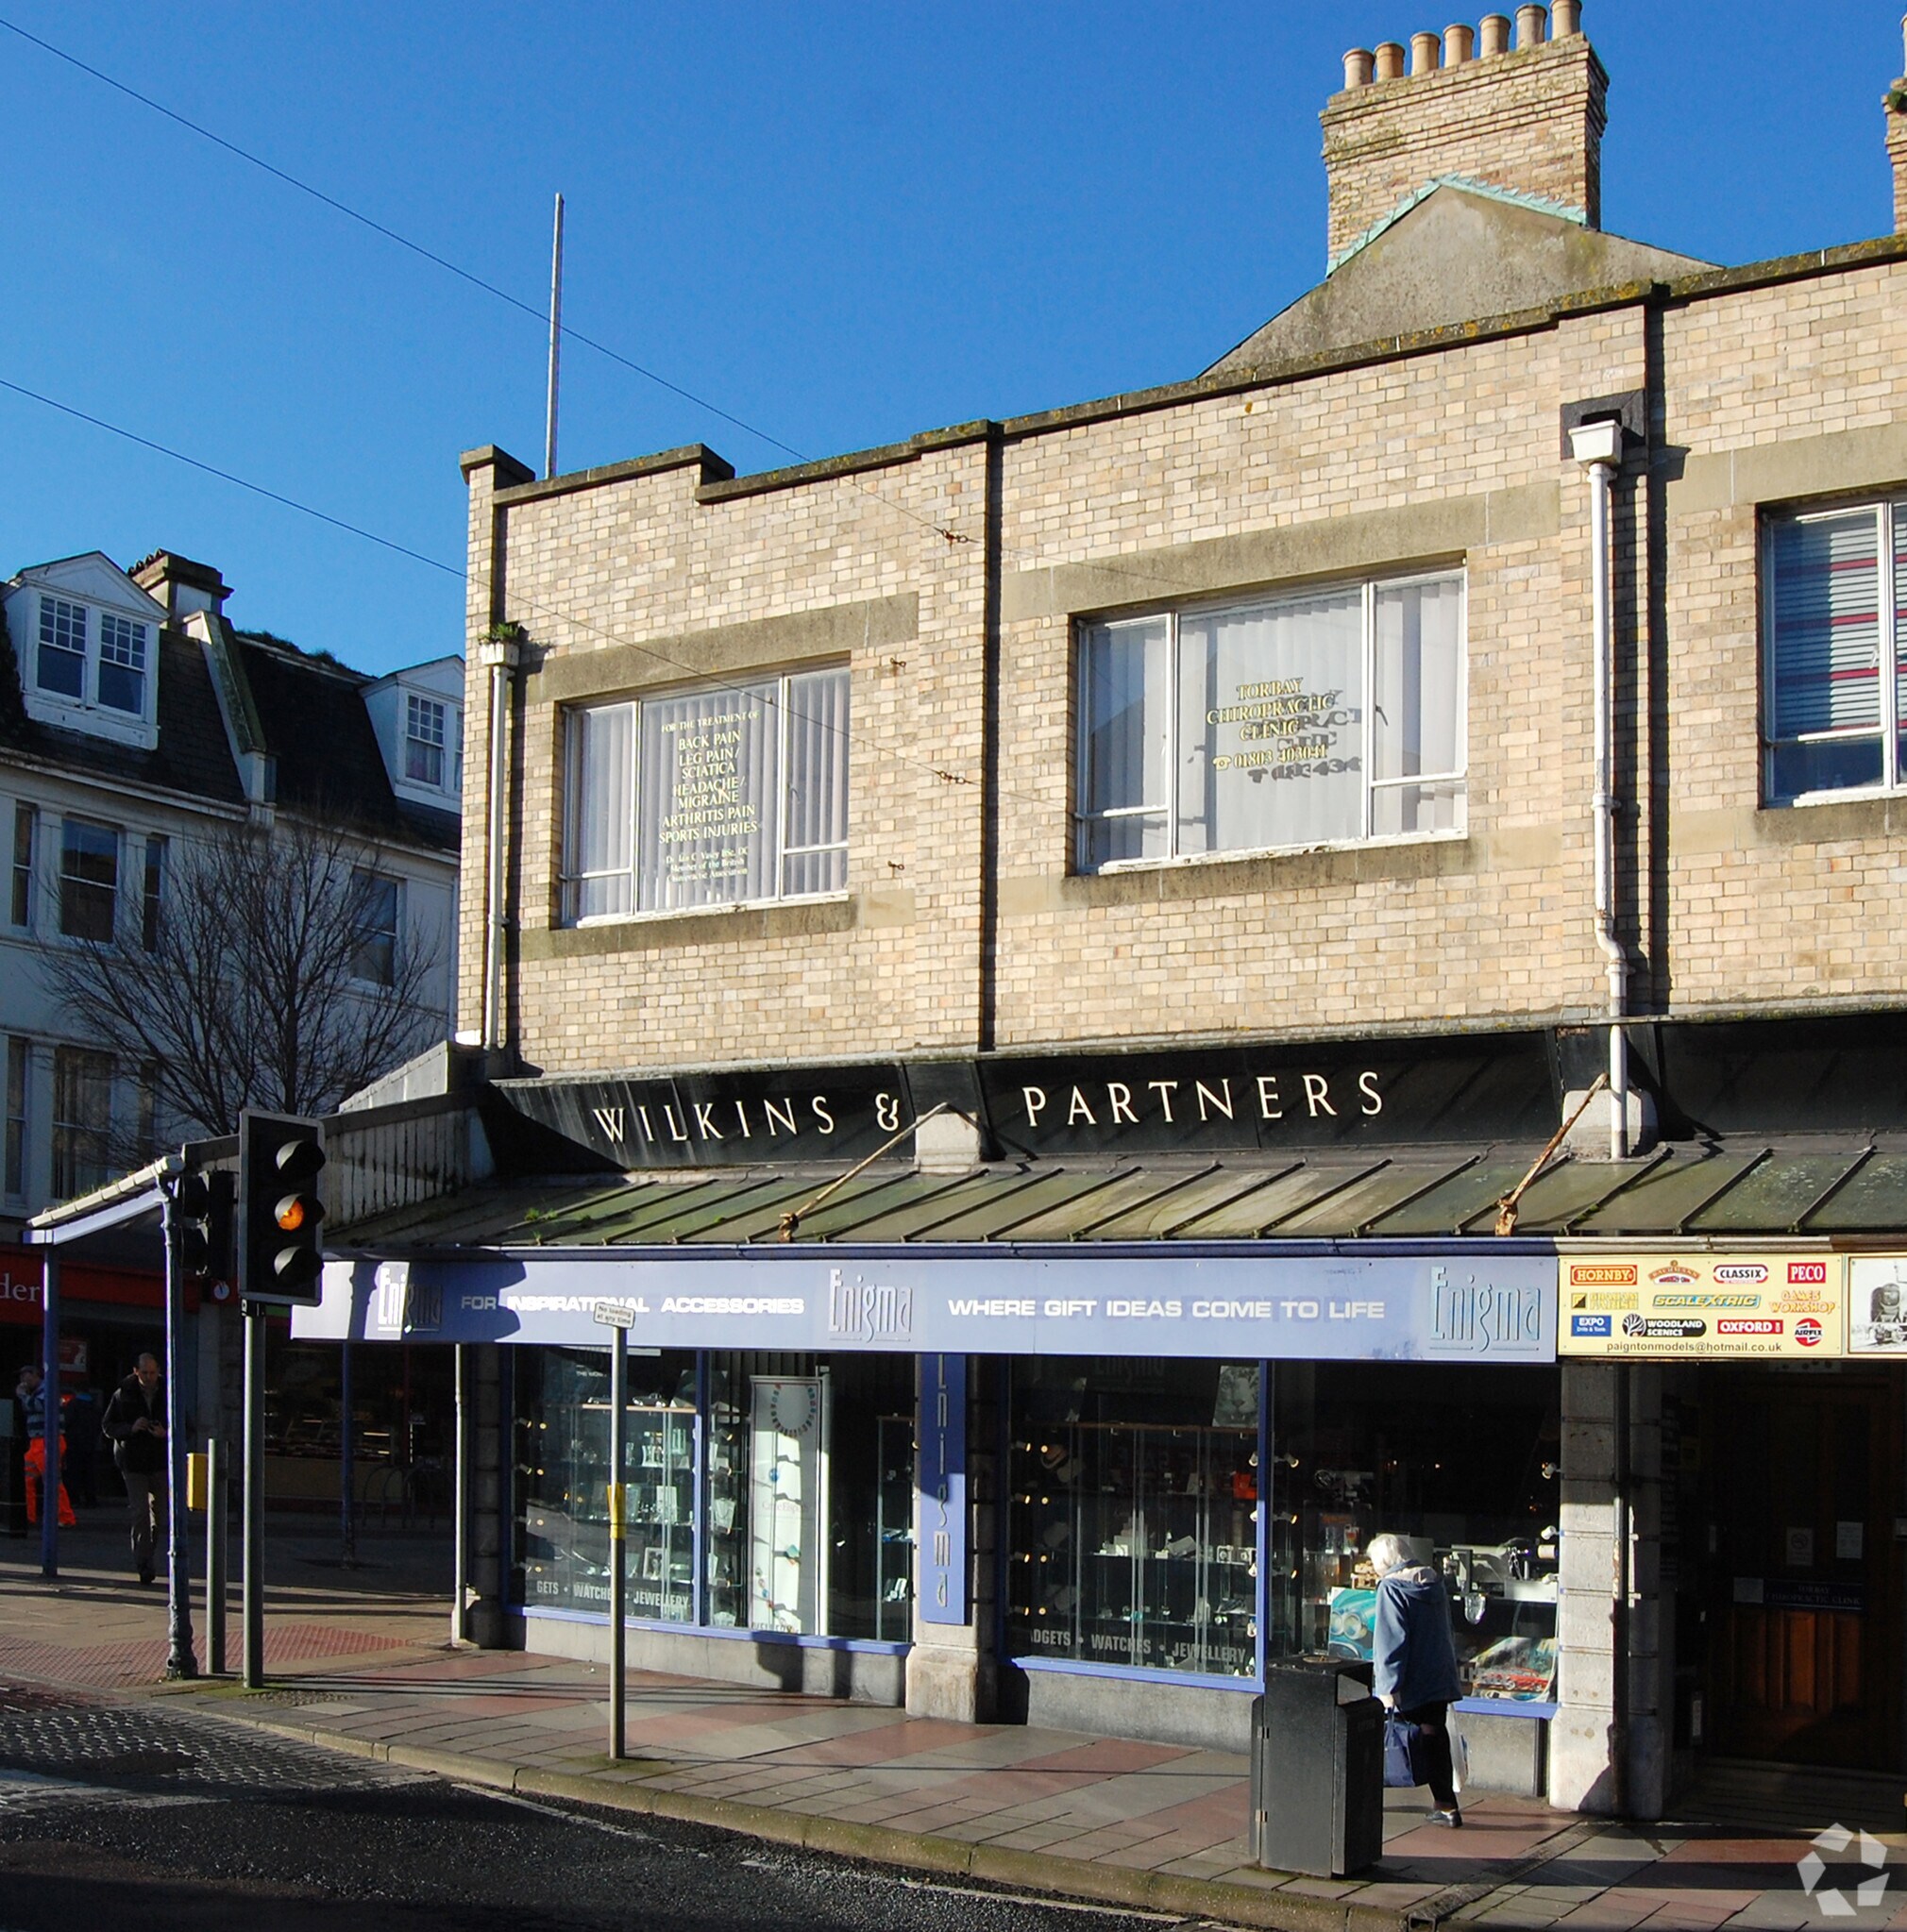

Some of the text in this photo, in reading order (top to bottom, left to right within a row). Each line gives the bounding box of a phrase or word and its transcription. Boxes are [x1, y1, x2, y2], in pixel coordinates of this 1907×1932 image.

[1236, 677, 1303, 700] TORBAY
[1206, 693, 1336, 725] CHIROPRACTIC
[662, 723, 677, 732] FOR
[680, 720, 695, 731] THE
[698, 711, 747, 728] TREATMENT
[1240, 720, 1300, 741] CLINIC
[678, 730, 741, 750] BACK PAIN
[679, 751, 702, 766] LEG
[1233, 749, 1274, 769] 01803
[682, 762, 735, 780] SCIATICA
[678, 789, 739, 810] MIGRAINE
[662, 804, 755, 828] ARTHRITIS PAIN
[659, 820, 758, 844] SPORTS INJURIES
[593, 1070, 1382, 1144] WILKINS & PARTNERS
[1577, 1269, 1632, 1281] HORNBY
[1720, 1268, 1762, 1279] CLASSIX
[1791, 1266, 1824, 1281] PECO
[461, 1296, 497, 1310] FOR
[661, 1297, 804, 1315] ACCESSORIES
[1654, 1295, 1757, 1308] SCALEXTRIC
[1781, 1290, 1821, 1302] GAMES
[829, 1268, 913, 1344] Enigma
[948, 1300, 1385, 1319] WHERE GIFT IDEAS COME TO LIFE
[1430, 1266, 1541, 1352] Enigma
[1769, 1301, 1835, 1315] WORKSHOP
[1578, 1317, 1604, 1326] EXPO
[1646, 1319, 1702, 1329] WOODLAND
[1719, 1321, 1772, 1333] OXFORD
[1607, 1342, 1782, 1353] paigntonmodels@hotmail.co.uk
[633, 1590, 689, 1608] JEWELLERY
[1030, 1629, 1246, 1663] DGETS WATCHES JEWELLERY
